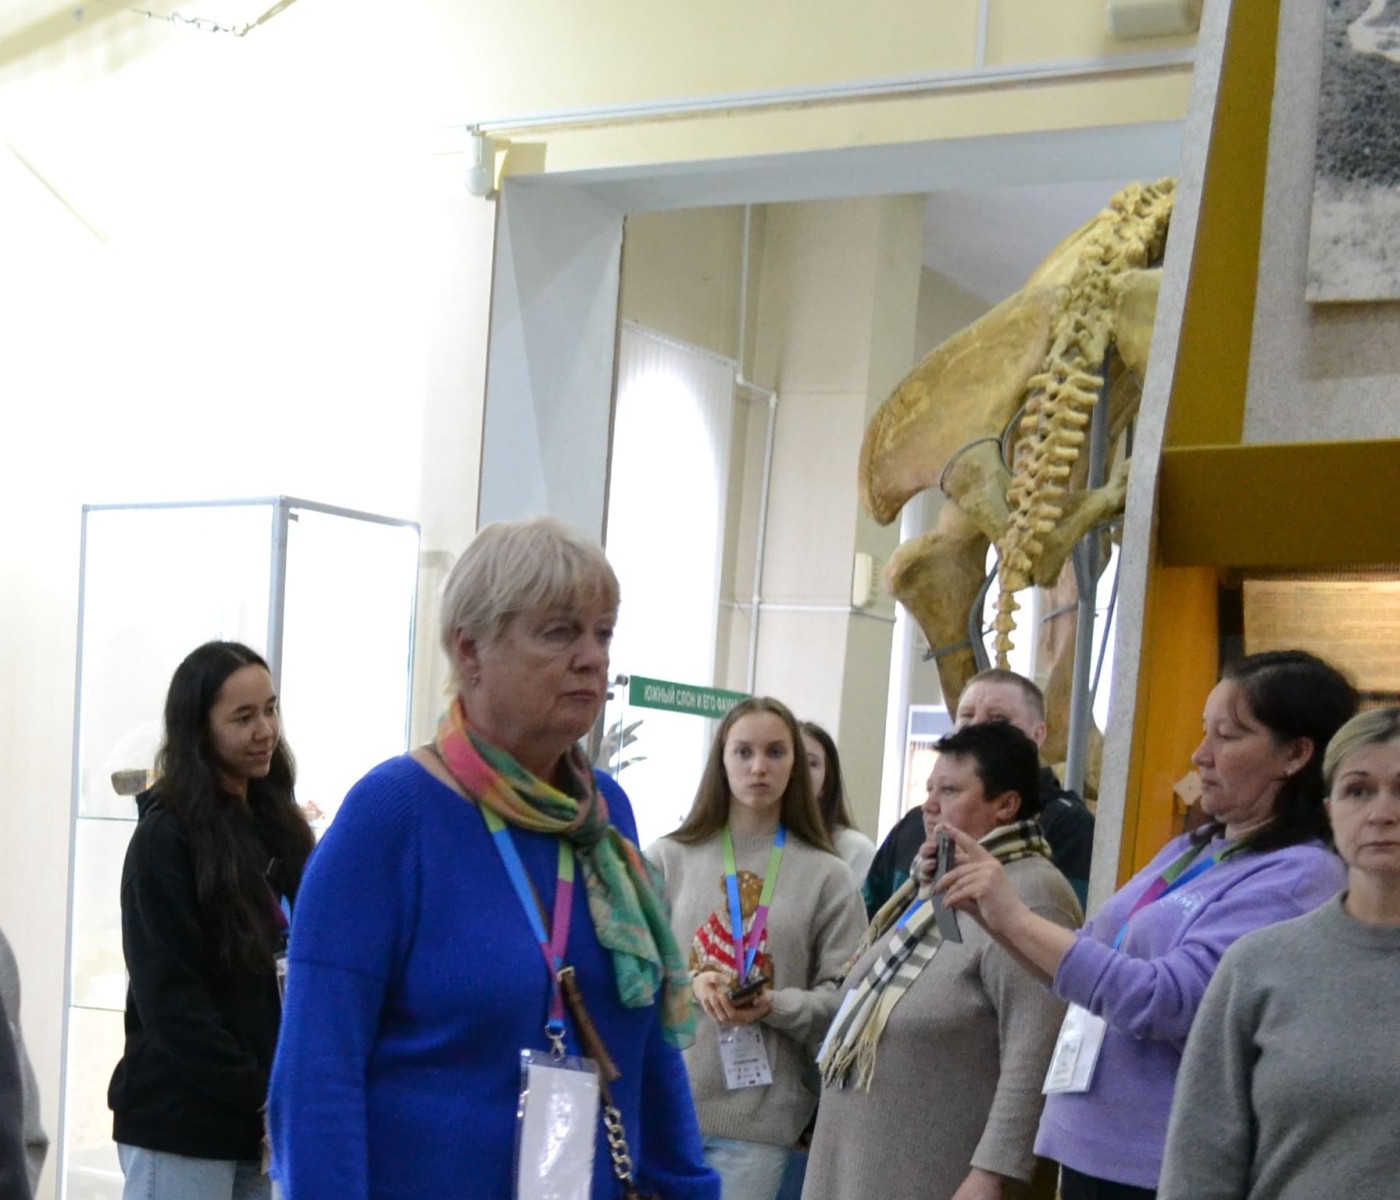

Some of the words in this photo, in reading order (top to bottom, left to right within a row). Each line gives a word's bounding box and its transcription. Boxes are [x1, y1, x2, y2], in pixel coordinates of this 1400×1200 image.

[644, 684, 675, 705] ЮЖНЫЙ
[676, 688, 696, 708] СЛОН
[697, 692, 702, 709] И
[703, 694, 716, 712] ЕГО
